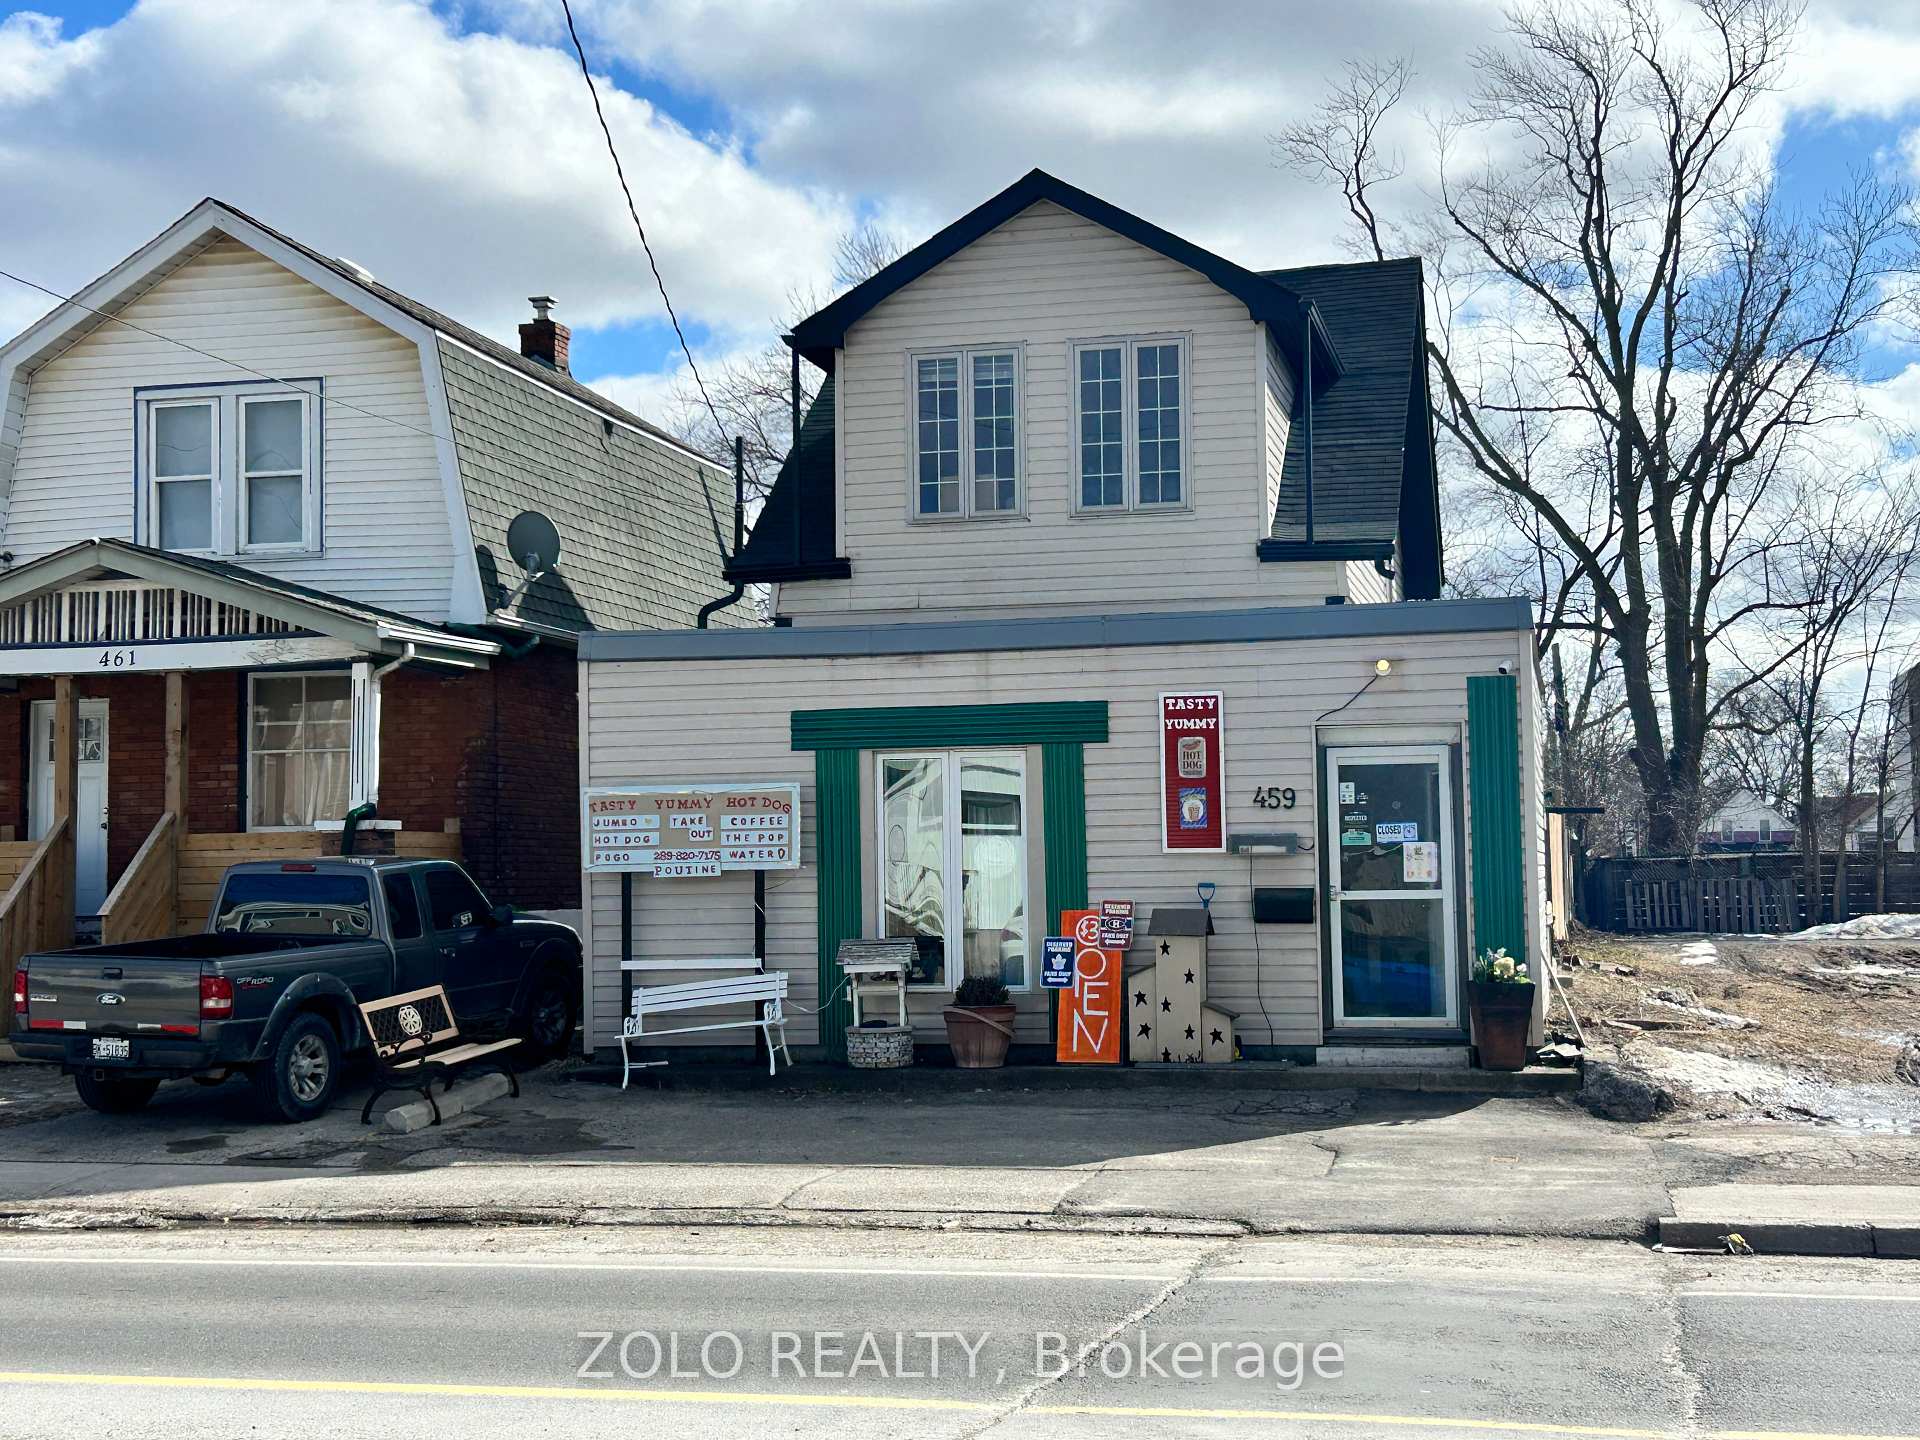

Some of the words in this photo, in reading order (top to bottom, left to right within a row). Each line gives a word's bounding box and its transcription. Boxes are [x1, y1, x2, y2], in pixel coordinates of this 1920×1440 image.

[98, 650, 136, 667] 461
[1165, 698, 1217, 711] TASTY
[1165, 717, 1217, 730] YUMMY
[1182, 751, 1202, 760] HOT
[1182, 760, 1203, 769] DOG
[1252, 786, 1297, 810] 459
[589, 799, 637, 813] TASTY
[655, 797, 714, 810] YUMMY
[726, 796, 758, 808] HOT
[761, 797, 792, 814] DOG
[593, 818, 638, 827] JUMBO
[671, 816, 704, 827] TAKE
[730, 816, 784, 827] COFFEE
[690, 829, 713, 839] OUT
[1377, 824, 1402, 835] CLOSED
[594, 836, 619, 845] HOT
[624, 835, 651, 845] DOG
[725, 833, 751, 843] THE
[758, 833, 785, 843] POP
[595, 853, 630, 862] POGO
[653, 850, 721, 862] 289-820-7175
[654, 865, 717, 877] POUTINE
